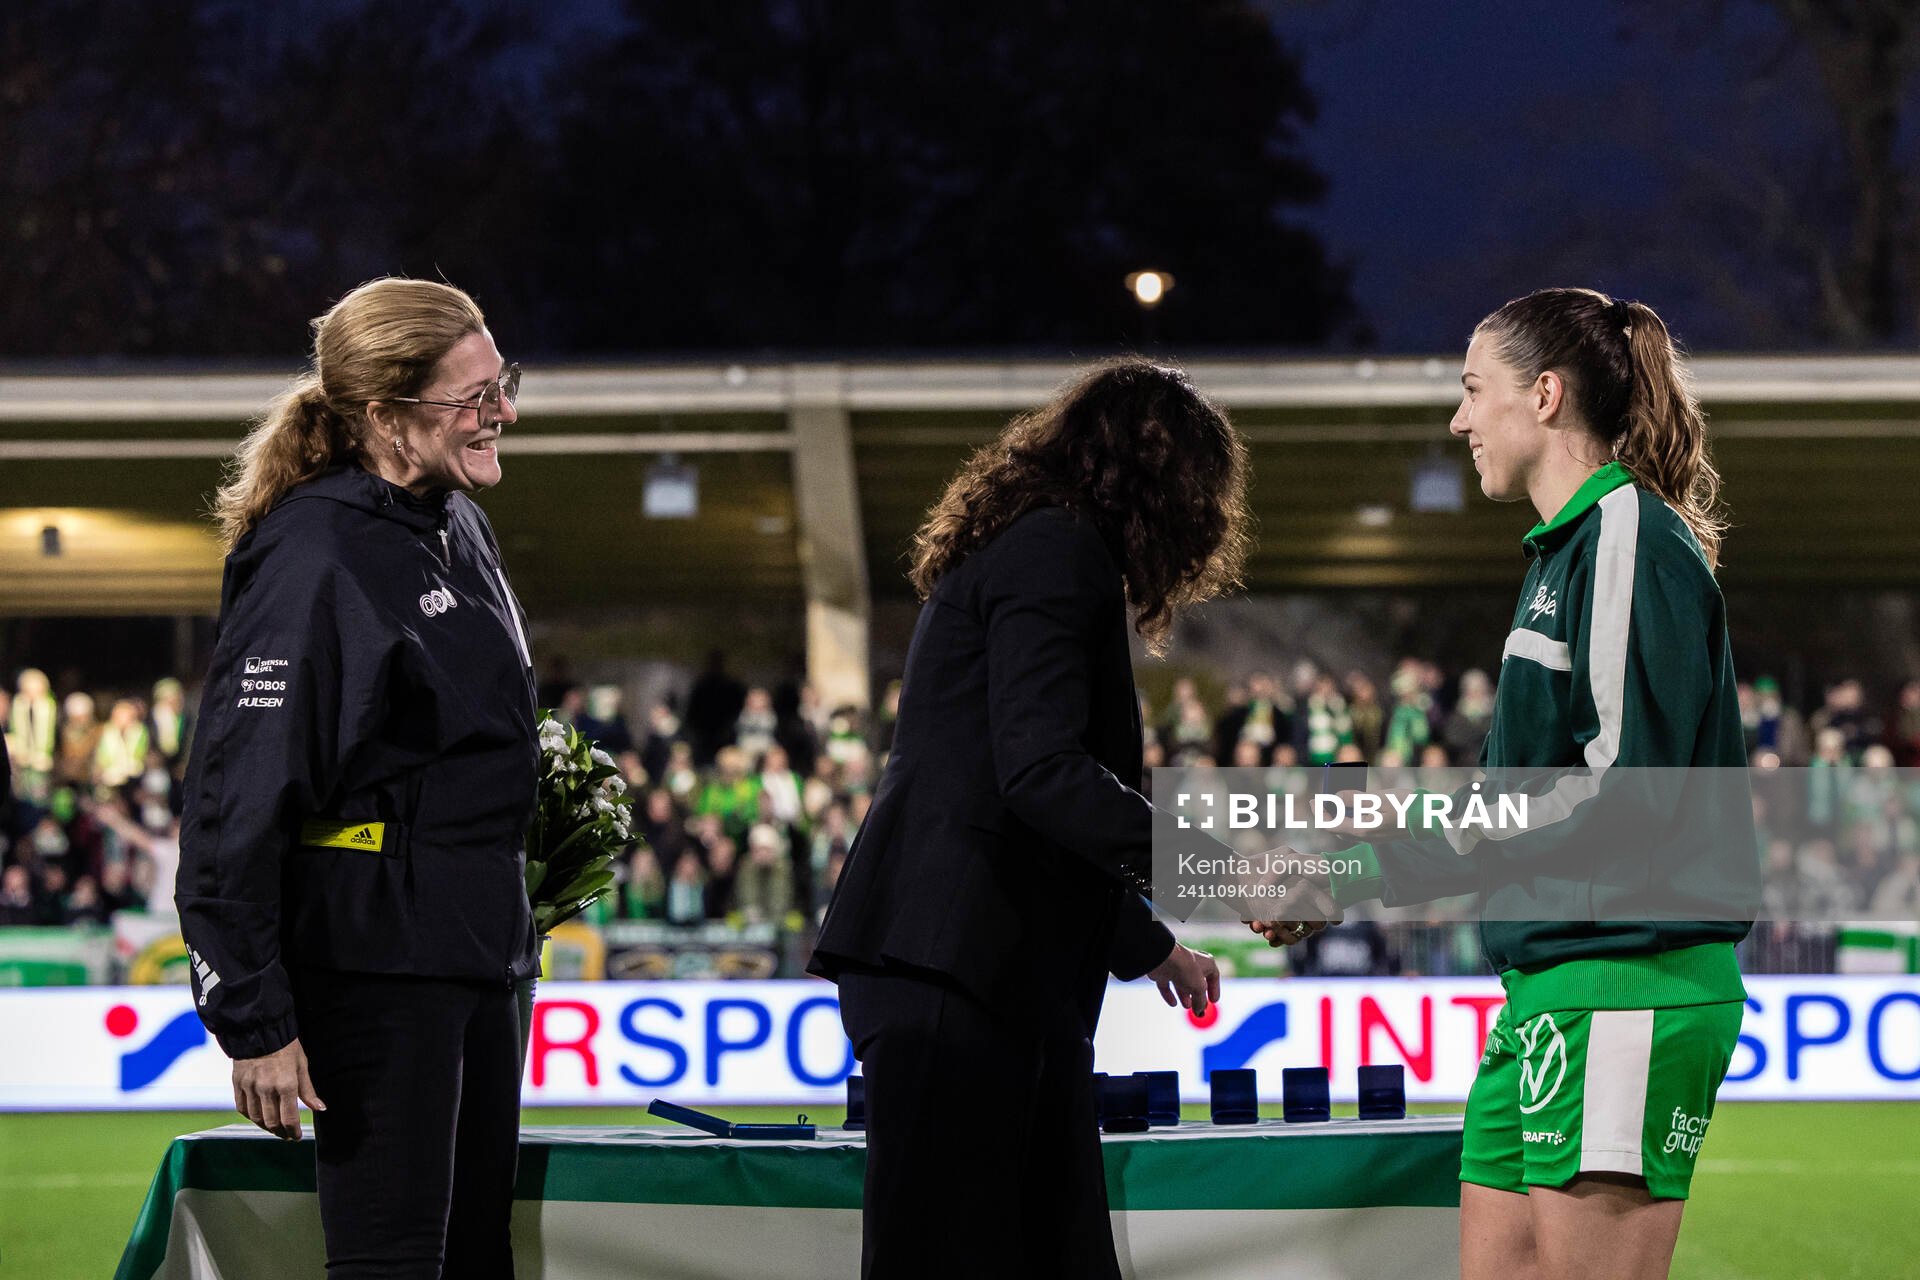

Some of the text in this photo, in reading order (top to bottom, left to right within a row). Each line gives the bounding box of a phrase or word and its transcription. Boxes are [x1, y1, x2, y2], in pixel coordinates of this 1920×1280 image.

[1529, 586, 1557, 621] Baje
[255, 680, 286, 690] OBOS
[237, 697, 283, 708] PULSEN
[350, 837, 375, 846] adidas
[531, 997, 856, 1087] RSPO
[1522, 1131, 1554, 1143] CRAFT
[1663, 1131, 1704, 1158] grup
